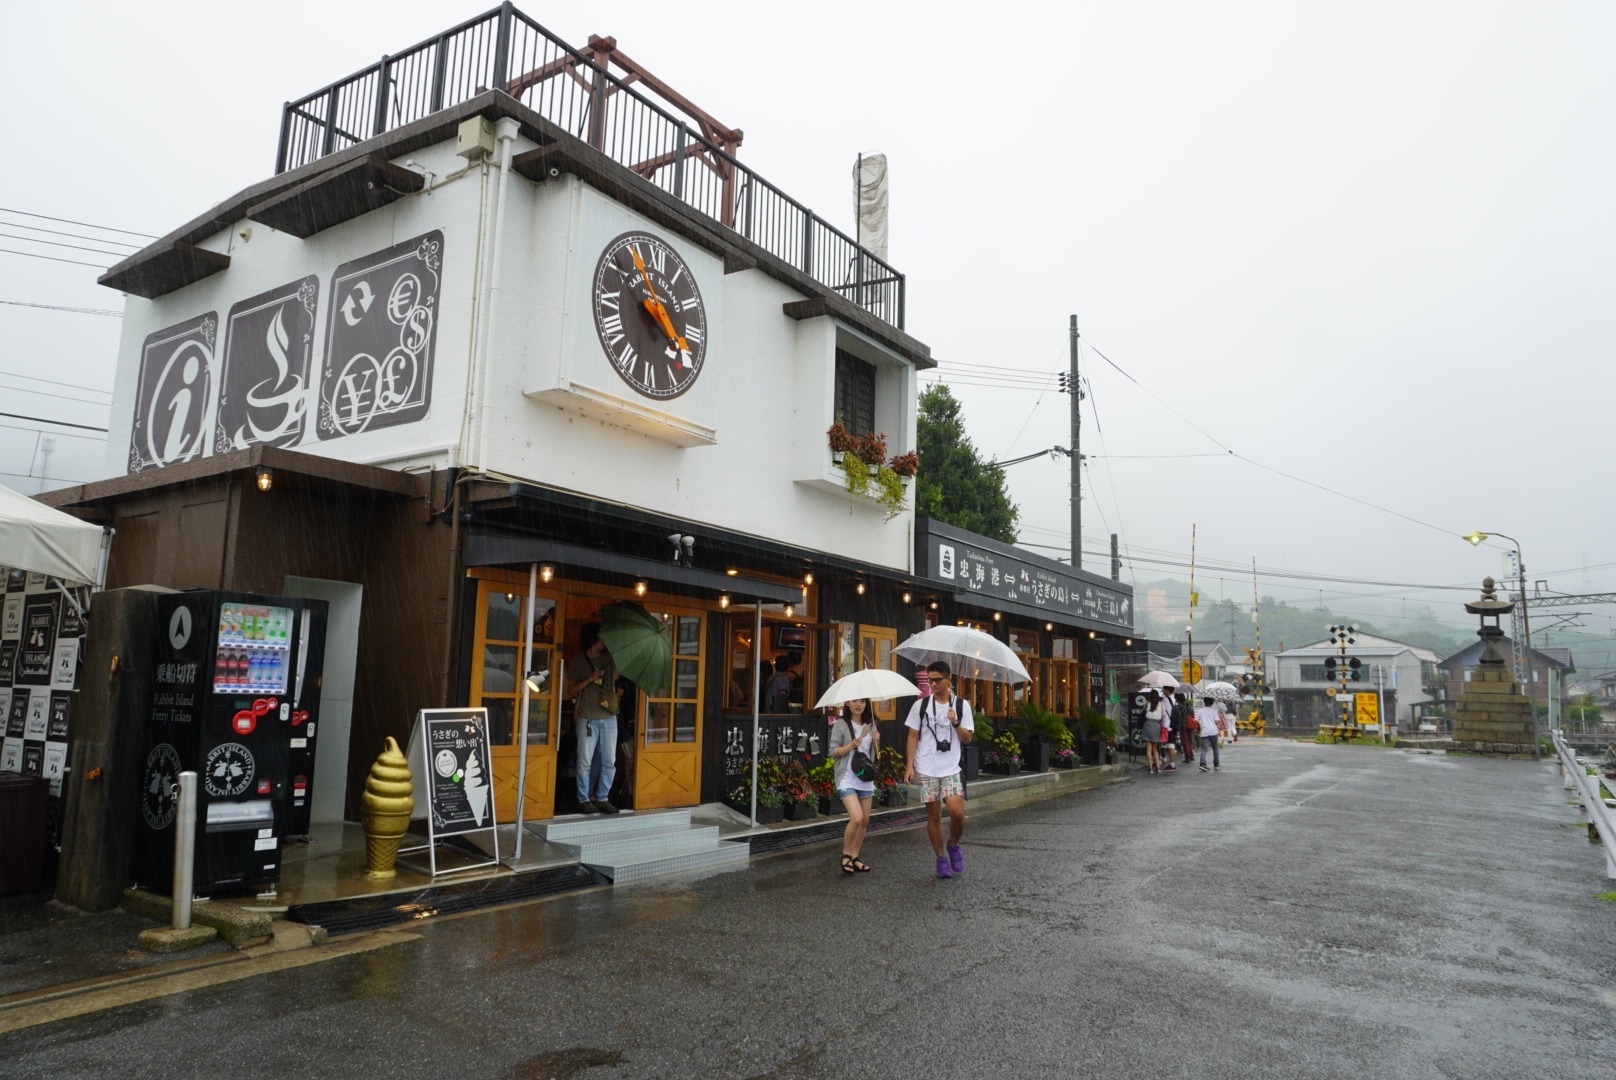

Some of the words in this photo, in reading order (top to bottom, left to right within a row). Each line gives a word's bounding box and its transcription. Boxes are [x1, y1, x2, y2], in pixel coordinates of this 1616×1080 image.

[648, 244, 666, 275] XII
[658, 278, 680, 312] ISLAND
[682, 297, 698, 311] II
[603, 314, 625, 347] VIII
[685, 323, 700, 343] III
[618, 342, 638, 375] VII
[644, 361, 656, 388] VI
[959, 558, 1000, 586] 忠海港
[1032, 580, 1064, 603] うさぎの島
[1097, 598, 1115, 616] 大三島
[32, 617, 49, 625] RABBIT
[26, 654, 45, 662] ISLAND
[155, 663, 197, 684] 乗船切符
[153, 693, 174, 705] Rabbit
[175, 693, 194, 706] Island
[152, 708, 168, 725] Ferry
[169, 709, 192, 723] Tickets
[432, 730, 459, 740] うさぎの
[456, 738, 478, 749] 想い出
[229, 746, 252, 765] ISLAND
[232, 770, 252, 795] RABBIT
